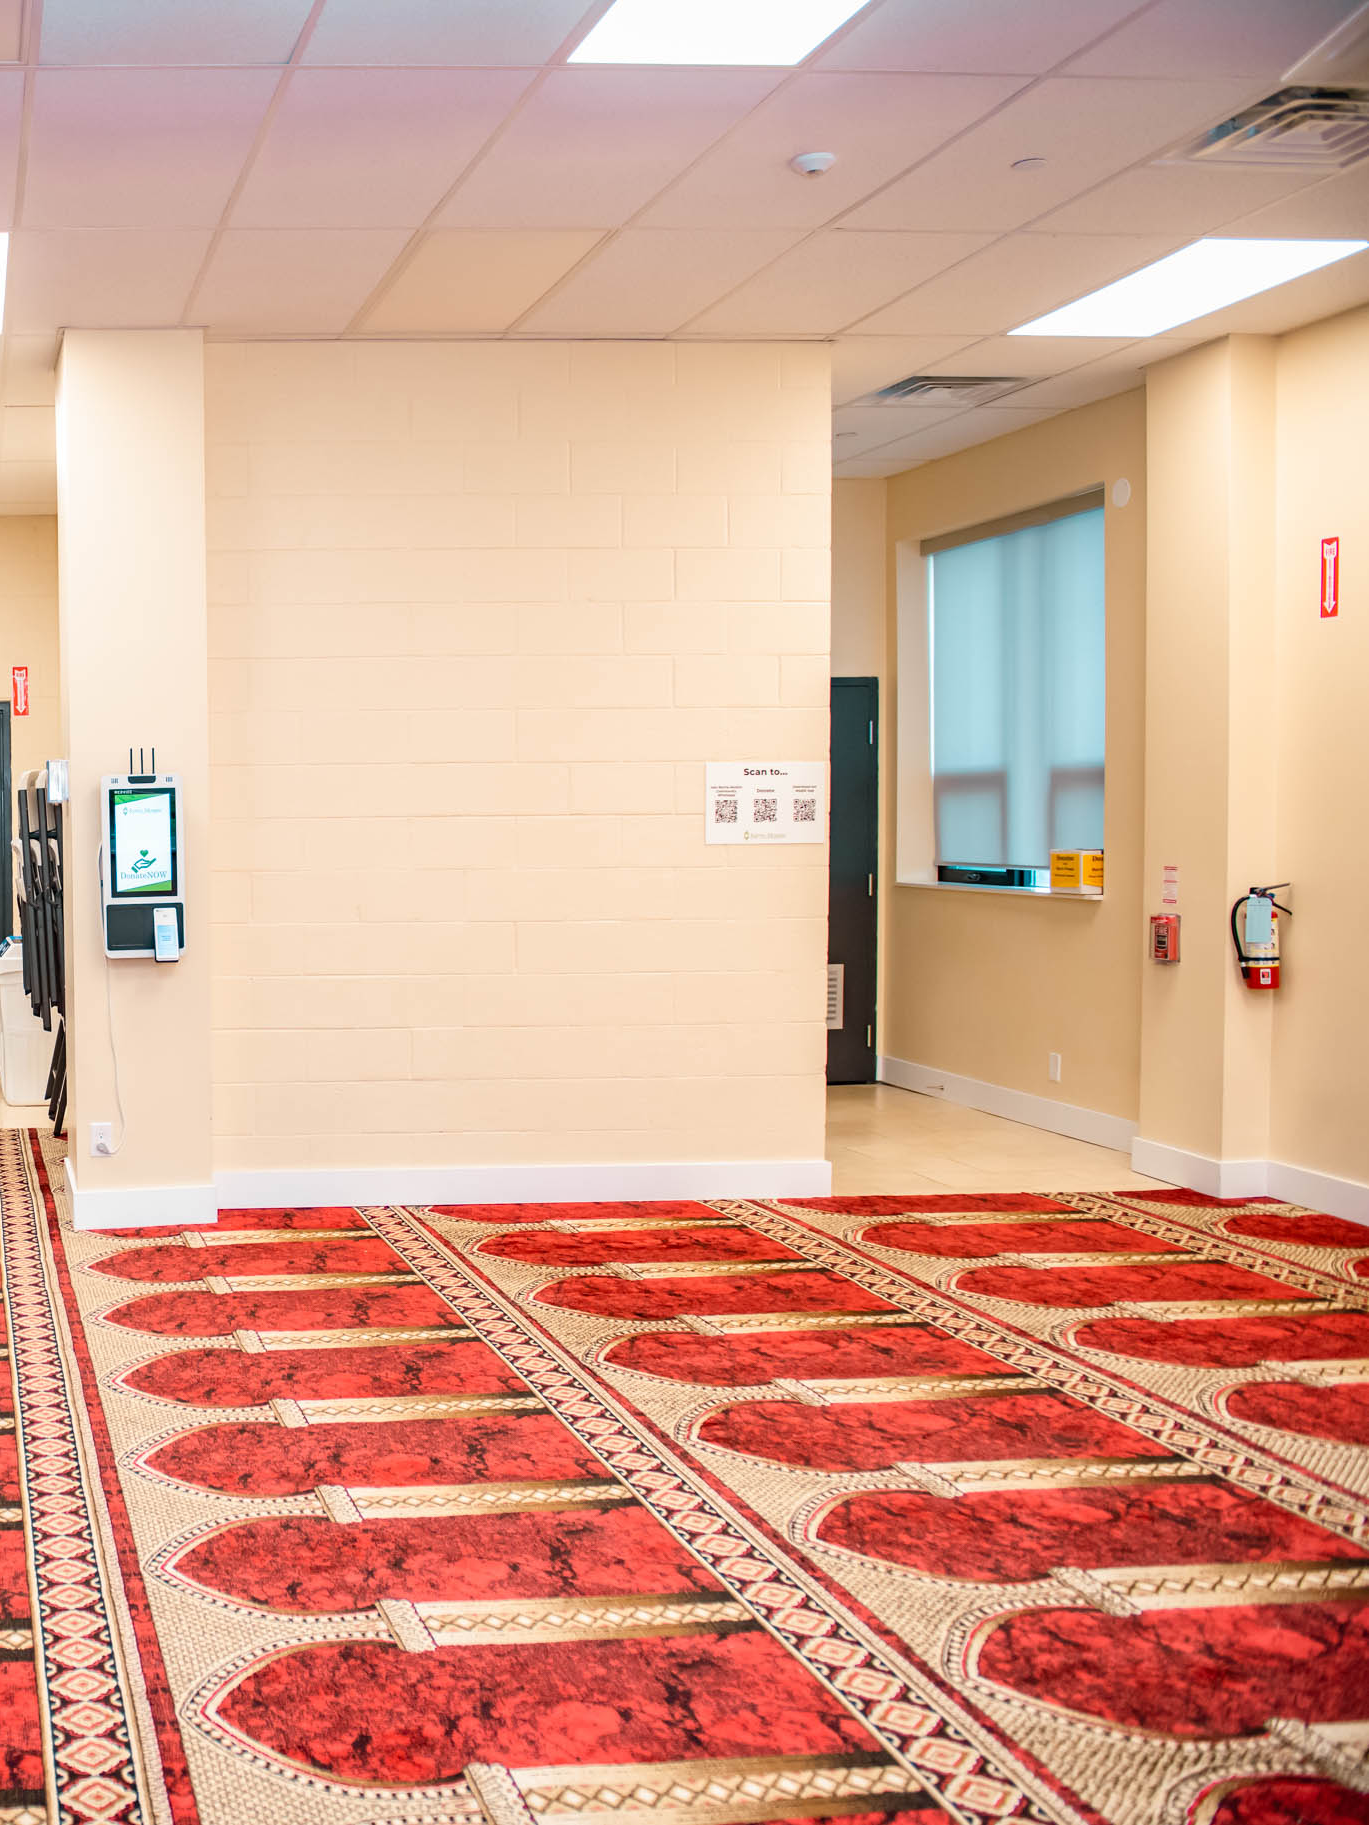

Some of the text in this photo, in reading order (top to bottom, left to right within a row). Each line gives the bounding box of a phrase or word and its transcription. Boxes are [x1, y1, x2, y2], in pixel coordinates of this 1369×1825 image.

[743, 768, 788, 776] Scan to...
[120, 871, 168, 880] DonateNOW
